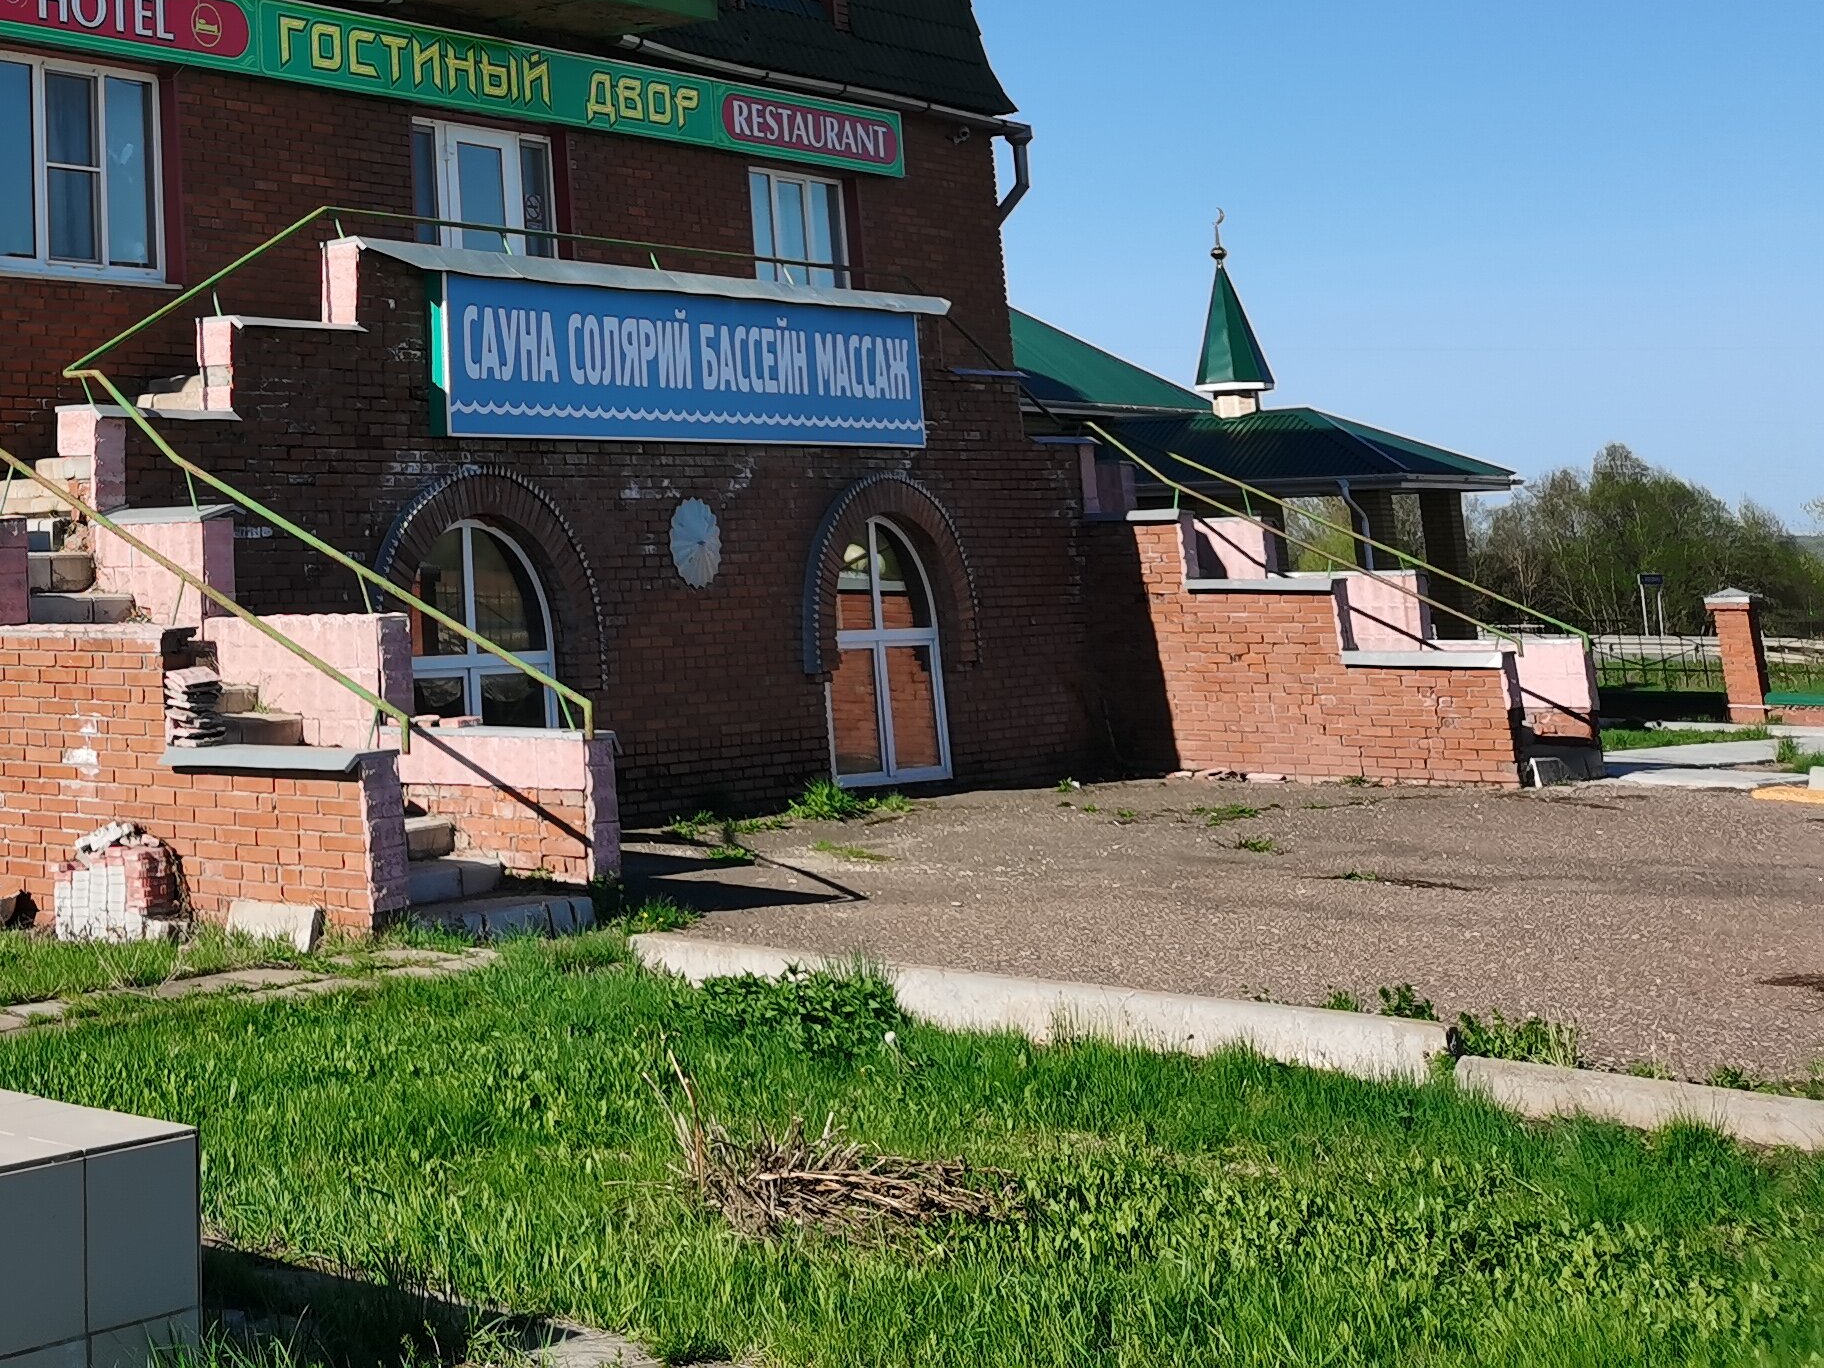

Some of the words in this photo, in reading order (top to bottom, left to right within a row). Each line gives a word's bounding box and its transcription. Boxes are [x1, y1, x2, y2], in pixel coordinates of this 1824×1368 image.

[280, 14, 553, 108] ГОСТИНЫЙ
[587, 70, 700, 128] ДВОР
[732, 100, 889, 159] RESTAURANT
[463, 305, 559, 383] САУНА
[569, 308, 693, 390] СОЛЯРИЙ
[700, 317, 809, 395] БАССЕЙН
[815, 334, 911, 400] МАССАЖ
